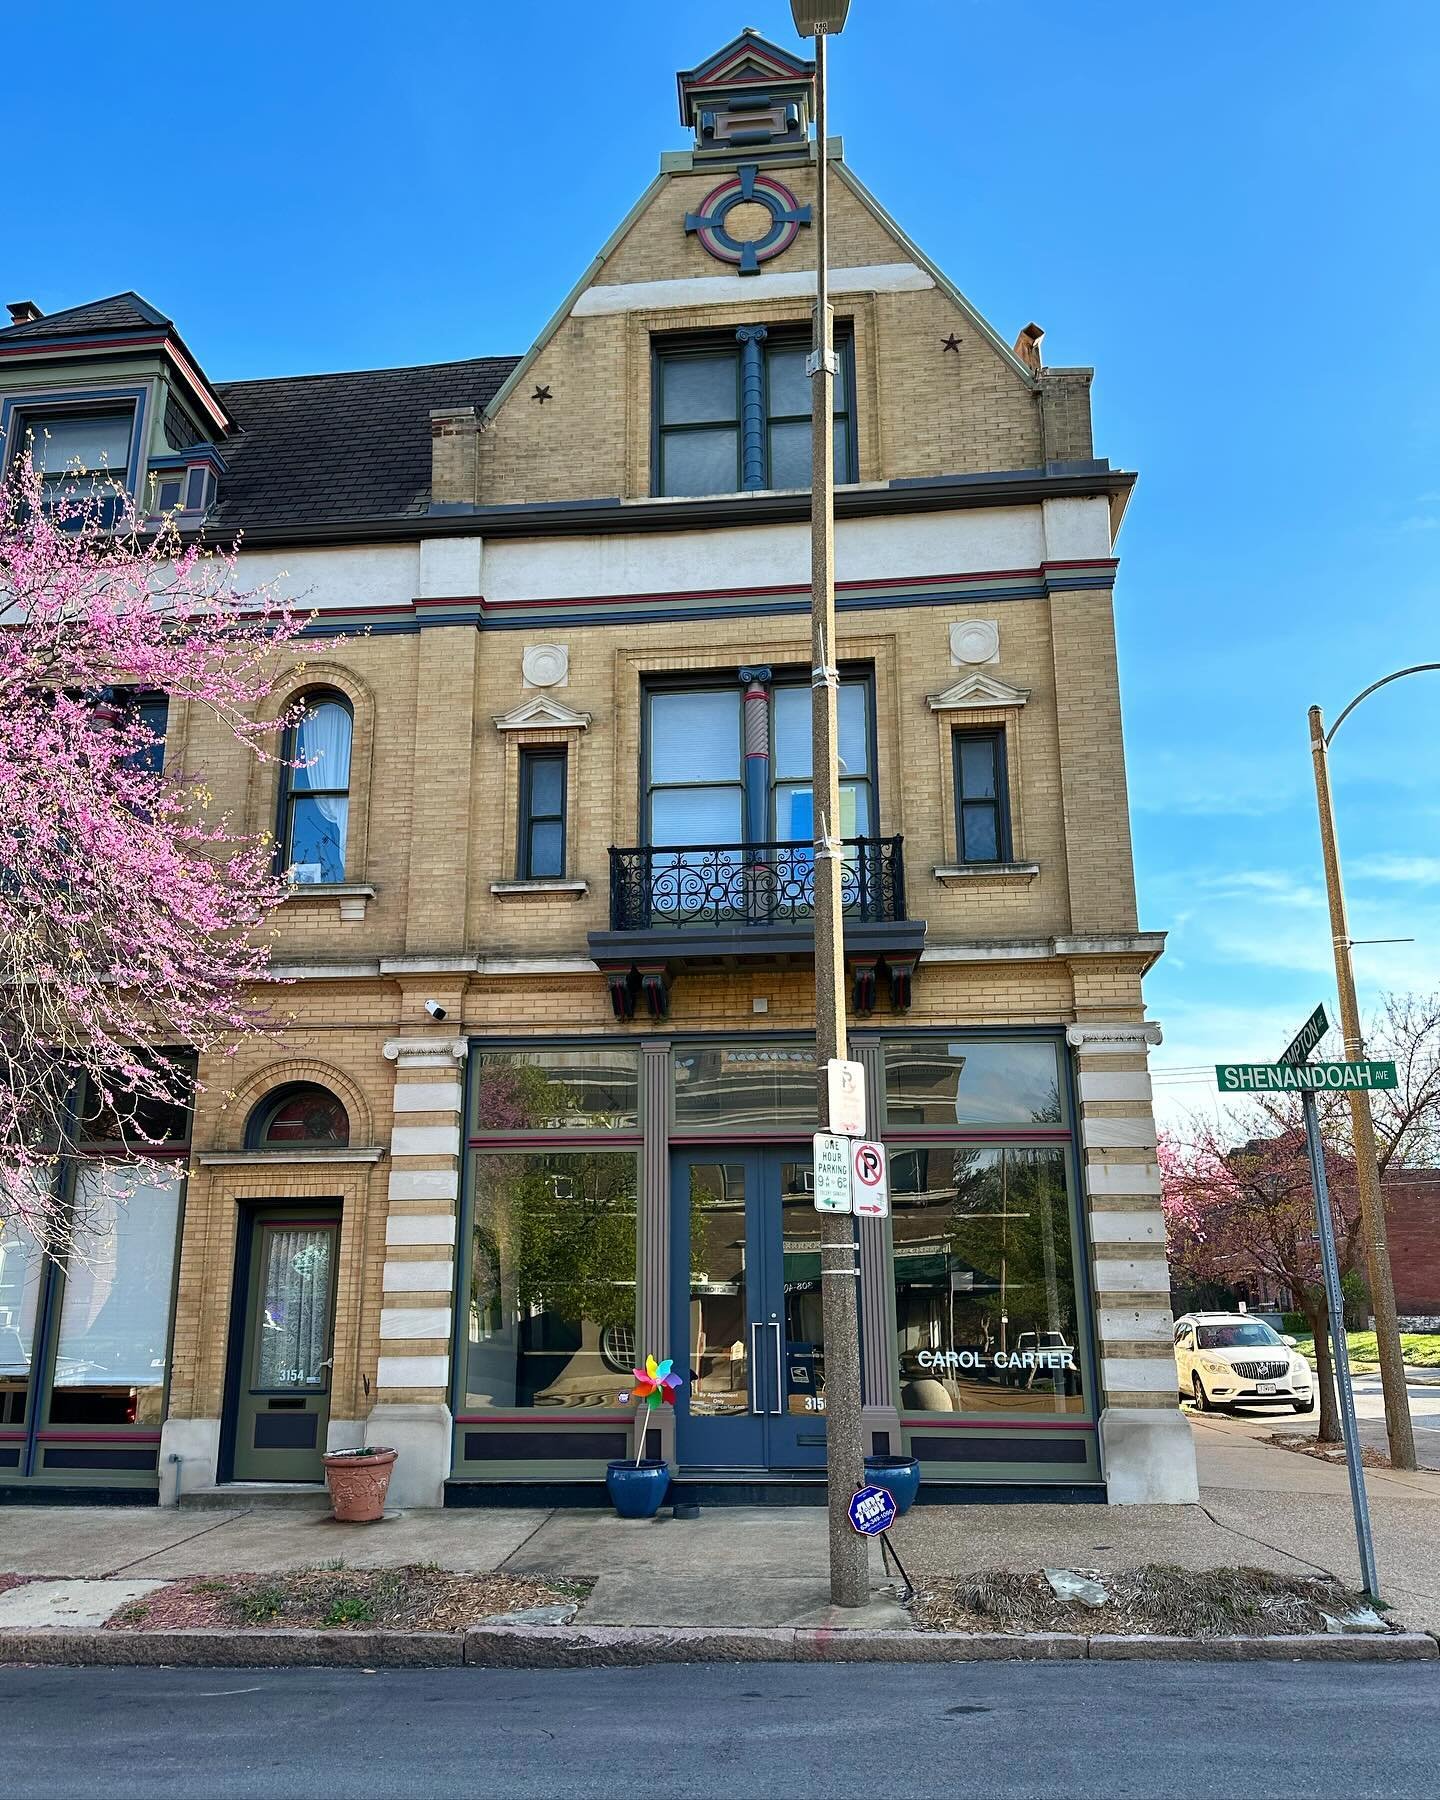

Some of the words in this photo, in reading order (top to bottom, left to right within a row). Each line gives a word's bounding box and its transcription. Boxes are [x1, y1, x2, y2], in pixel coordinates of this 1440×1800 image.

[1224, 1065, 1372, 1089] SHENANDOAH
[1375, 1070, 1389, 1080] AVE
[824, 1140, 840, 1150] ONE
[822, 1152, 842, 1162] HOUR
[818, 1163, 847, 1175] PARKING
[917, 1350, 986, 1368] CAROL
[993, 1351, 1074, 1369] CARTER
[279, 1369, 304, 1381] 3154
[804, 1397, 827, 1411] 315
